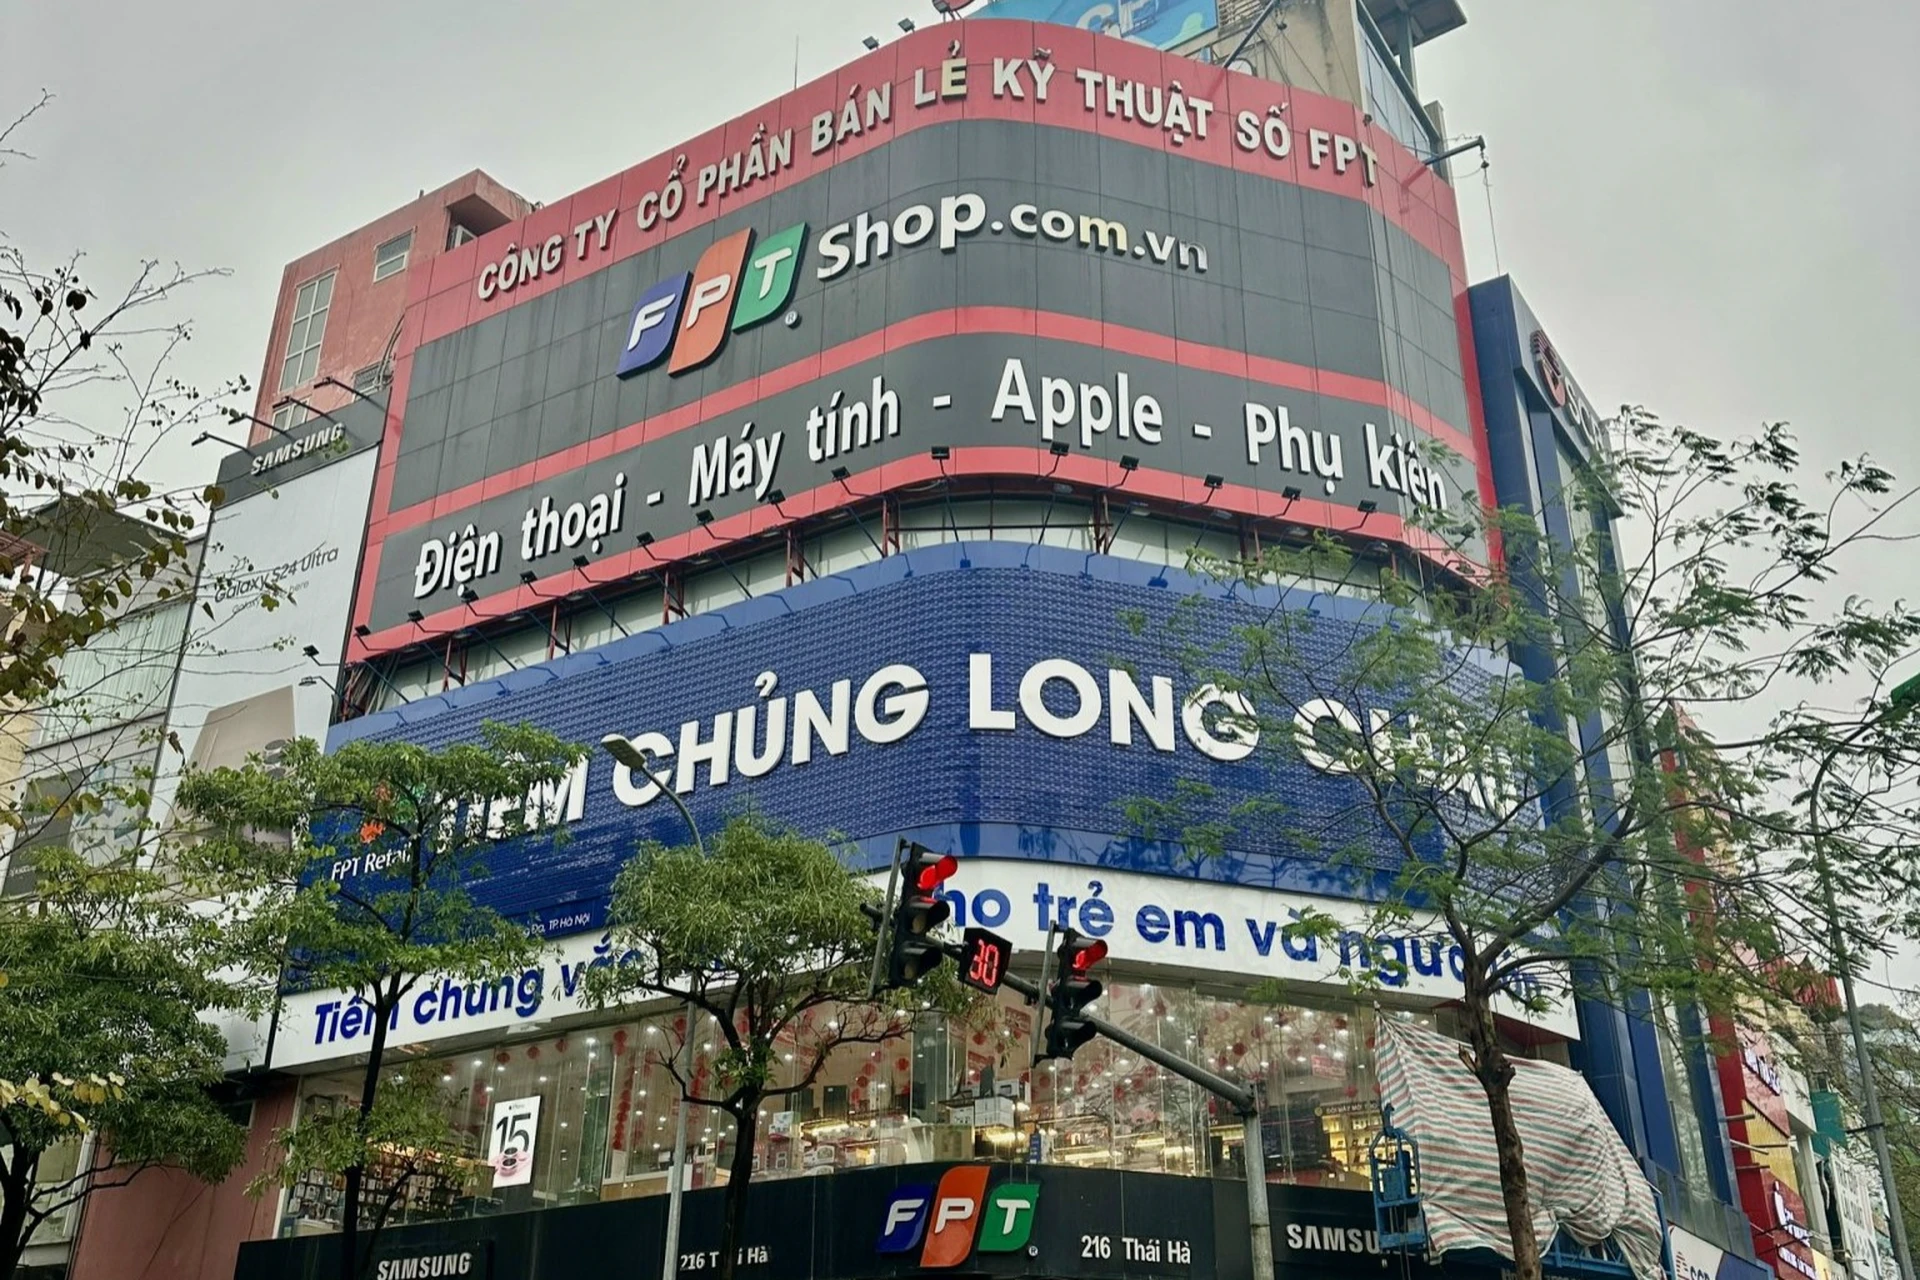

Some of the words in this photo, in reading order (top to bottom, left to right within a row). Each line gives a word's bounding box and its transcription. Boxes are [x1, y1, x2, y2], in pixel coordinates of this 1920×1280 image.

[477, 234, 563, 299] CÔNG
[574, 208, 619, 260] TY
[636, 154, 689, 231] CỔ
[697, 122, 793, 205] PHẦN
[810, 82, 892, 155] BÁN
[913, 39, 968, 108] LẺ
[992, 46, 1056, 101] KỸ
[1075, 68, 1215, 146] THUẬT
[1236, 101, 1292, 158] SỐ
[1309, 127, 1378, 187] FPT
[626, 247, 793, 353] FPT
[816, 191, 1209, 281] Shop.com.vn
[250, 421, 347, 476] SAMSUNG
[413, 523, 501, 599] Điện
[520, 472, 627, 561] thoại
[688, 422, 784, 506] Máy
[806, 375, 900, 463] tính
[990, 357, 1163, 448] Apple
[1244, 402, 1344, 495] Phụ
[1363, 423, 1449, 517] kiện
[214, 573, 269, 603] Galaxy
[271, 559, 298, 583] S24
[300, 546, 339, 572] Ultra
[613, 664, 930, 807] CHỦNG
[968, 653, 1260, 762] LONG
[330, 855, 362, 881] FPT
[933, 878, 1011, 928] ho
[1033, 880, 1114, 938] trẻ
[1135, 903, 1225, 952] em
[1244, 908, 1319, 964] và
[968, 938, 1000, 988] 30
[496, 1112, 532, 1154] 15
[680, 1252, 706, 1271] 216
[709, 1246, 743, 1267] Ti
[746, 1245, 769, 1265] Hà
[1080, 1235, 1112, 1260] 216
[1120, 1236, 1162, 1263] Thái
[1166, 1239, 1192, 1265] Hà
[1286, 1223, 1381, 1255] SAMSU
[377, 1252, 472, 1280] SAMSUNG
